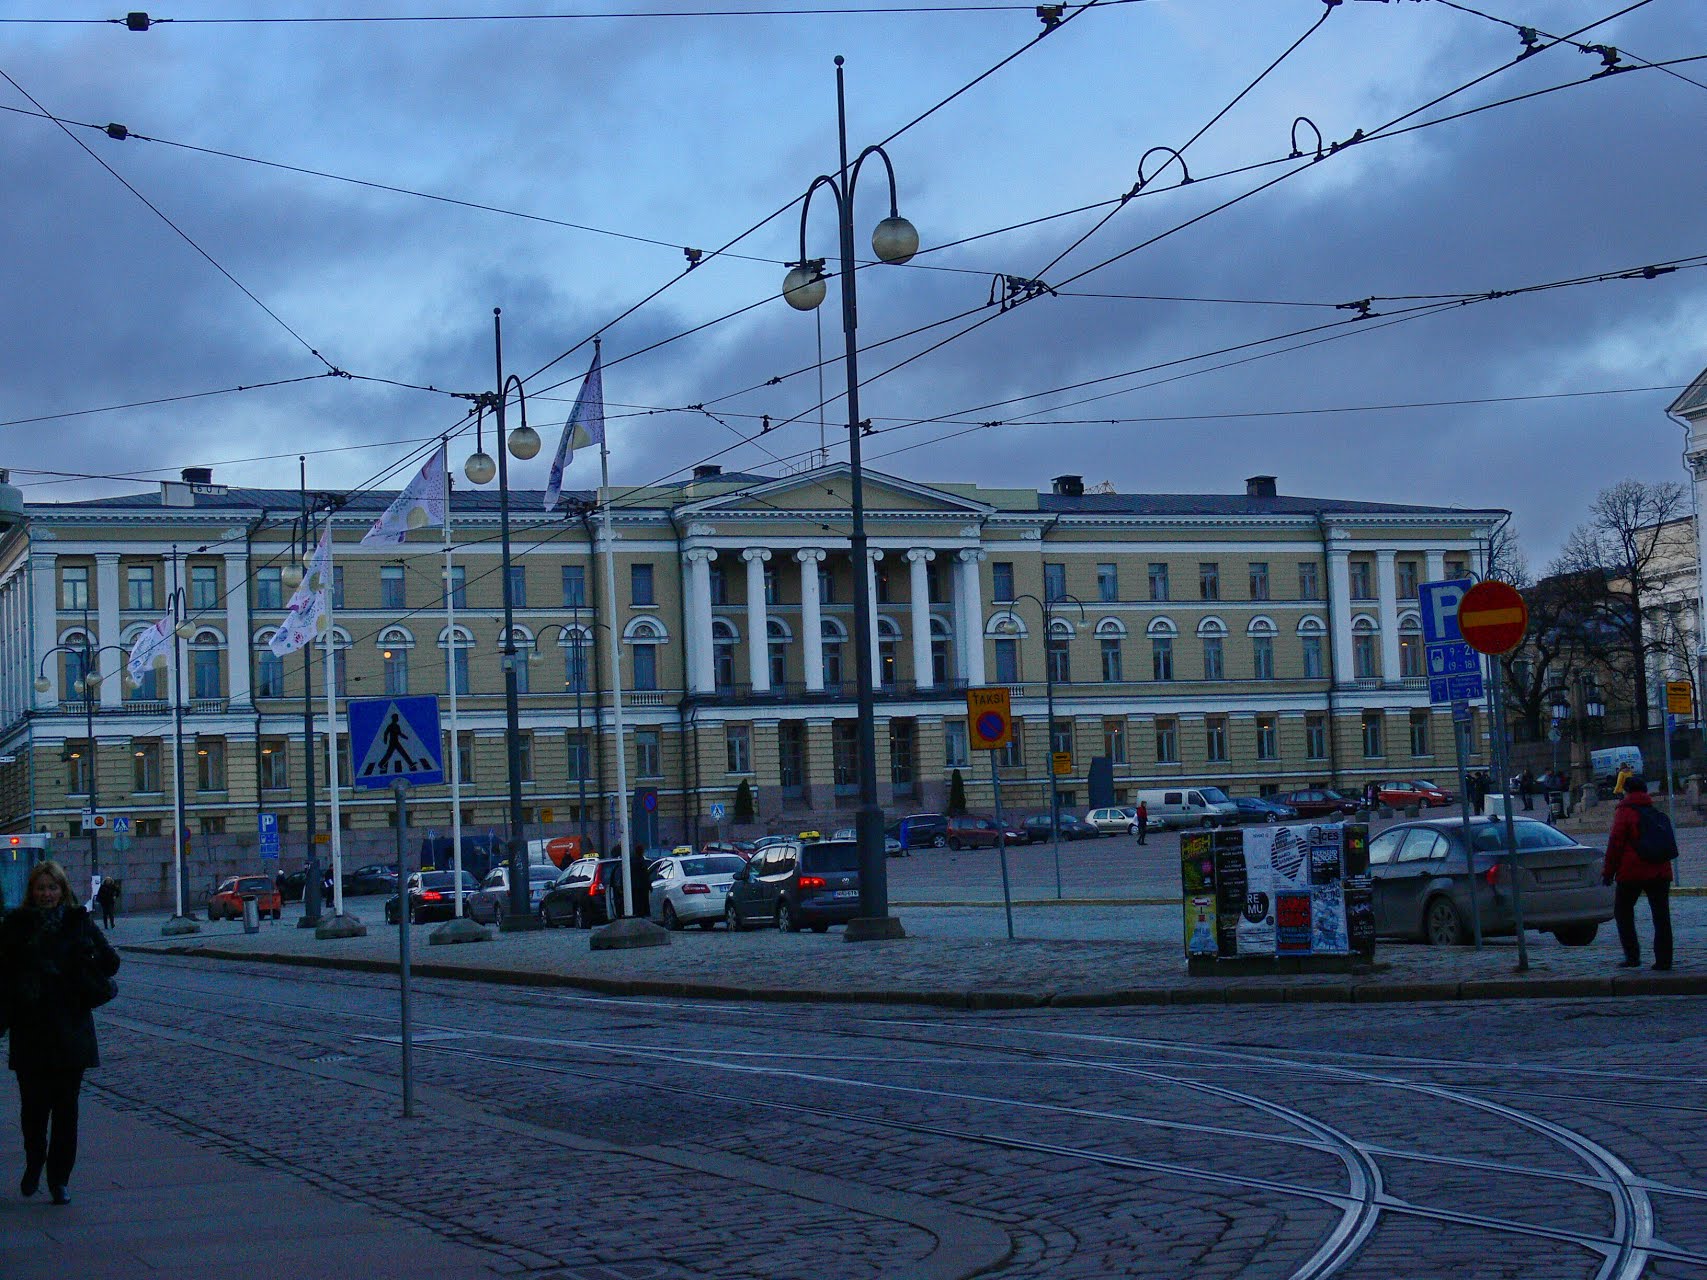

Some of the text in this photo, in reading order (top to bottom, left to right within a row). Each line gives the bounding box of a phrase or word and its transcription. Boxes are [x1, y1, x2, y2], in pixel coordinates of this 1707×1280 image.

[1431, 586, 1465, 638] P
[1450, 648, 1455, 658] 9
[1466, 688, 1471, 698] 2
[974, 694, 1004, 705] TAKSI
[262, 815, 275, 832] P
[1247, 894, 1260, 903] RE
[1248, 903, 1263, 914] MU
